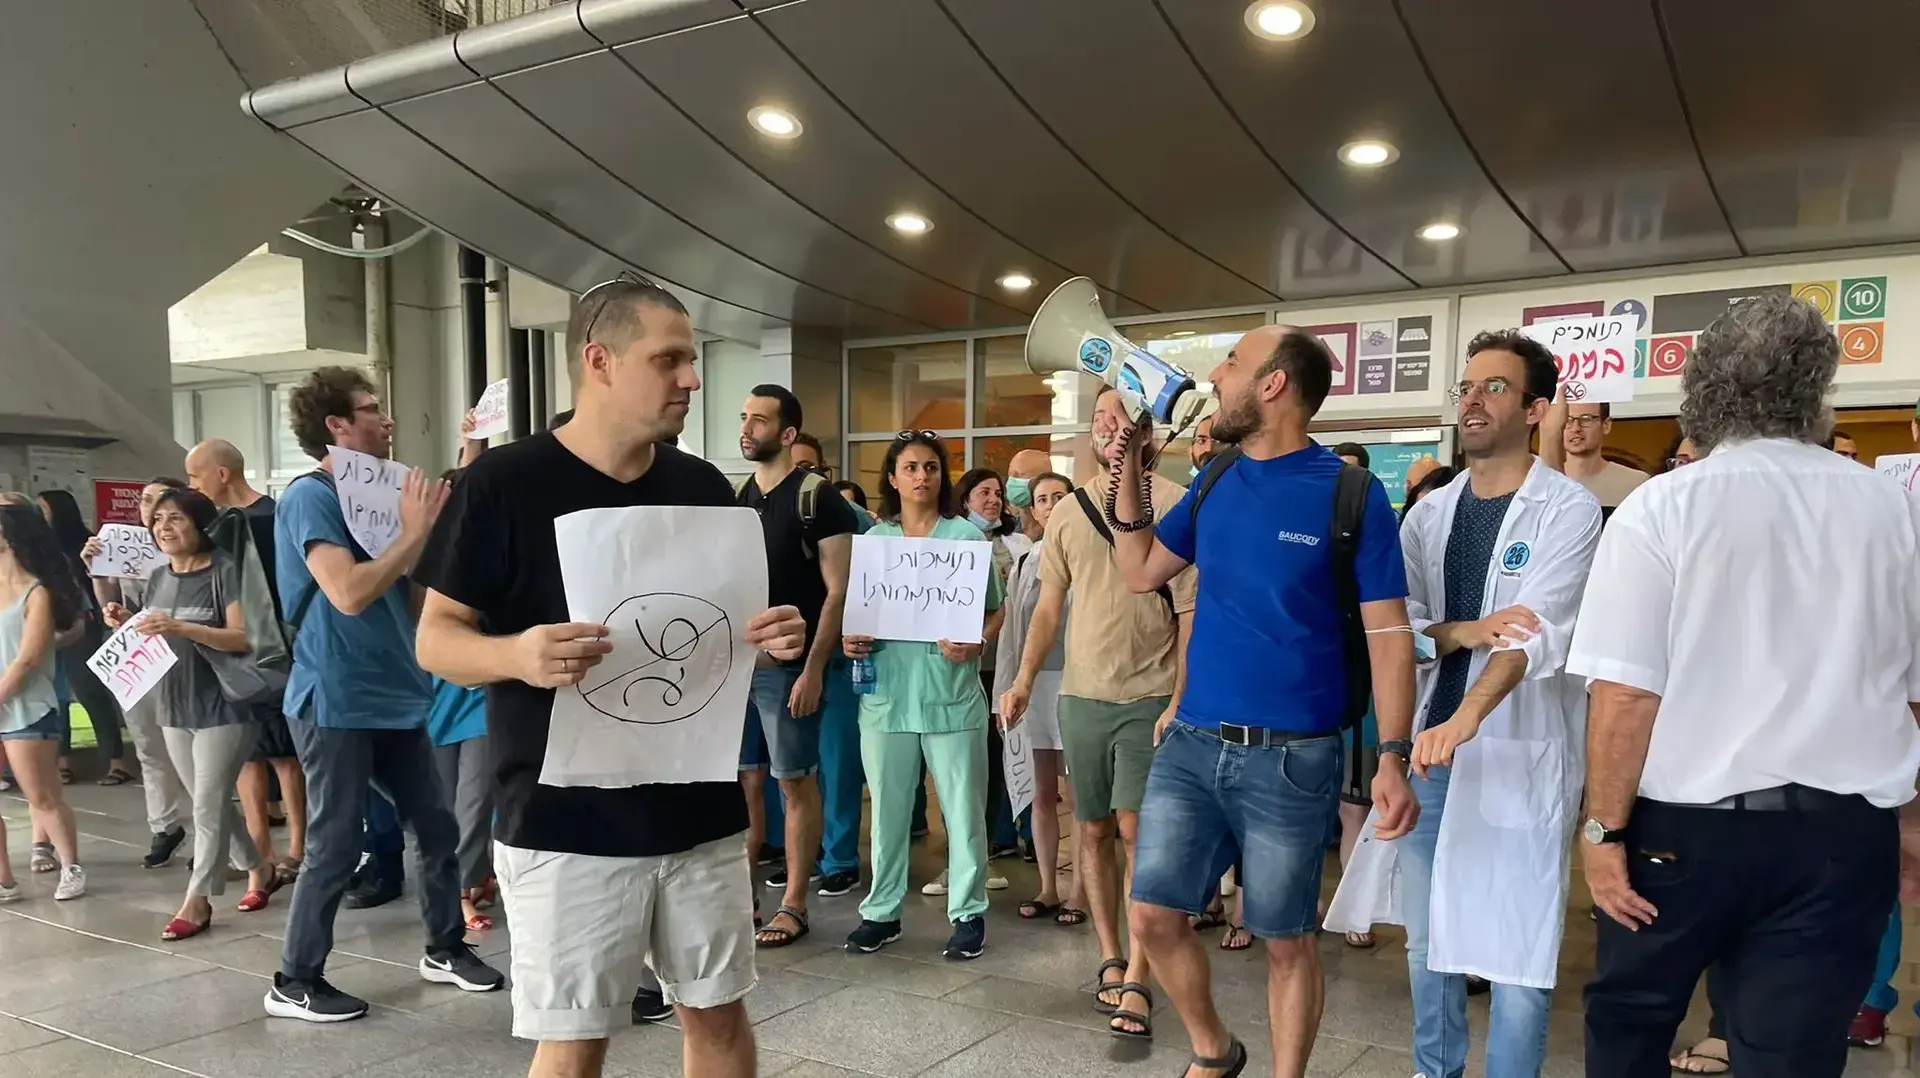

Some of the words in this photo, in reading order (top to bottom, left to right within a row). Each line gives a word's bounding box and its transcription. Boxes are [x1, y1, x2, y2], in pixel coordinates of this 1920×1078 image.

[1852, 290, 1874, 307] 10
[1552, 321, 1622, 345] תומכים
[1852, 336, 1865, 351] 4
[1663, 349, 1676, 365] 6
[886, 551, 975, 580] תומכות
